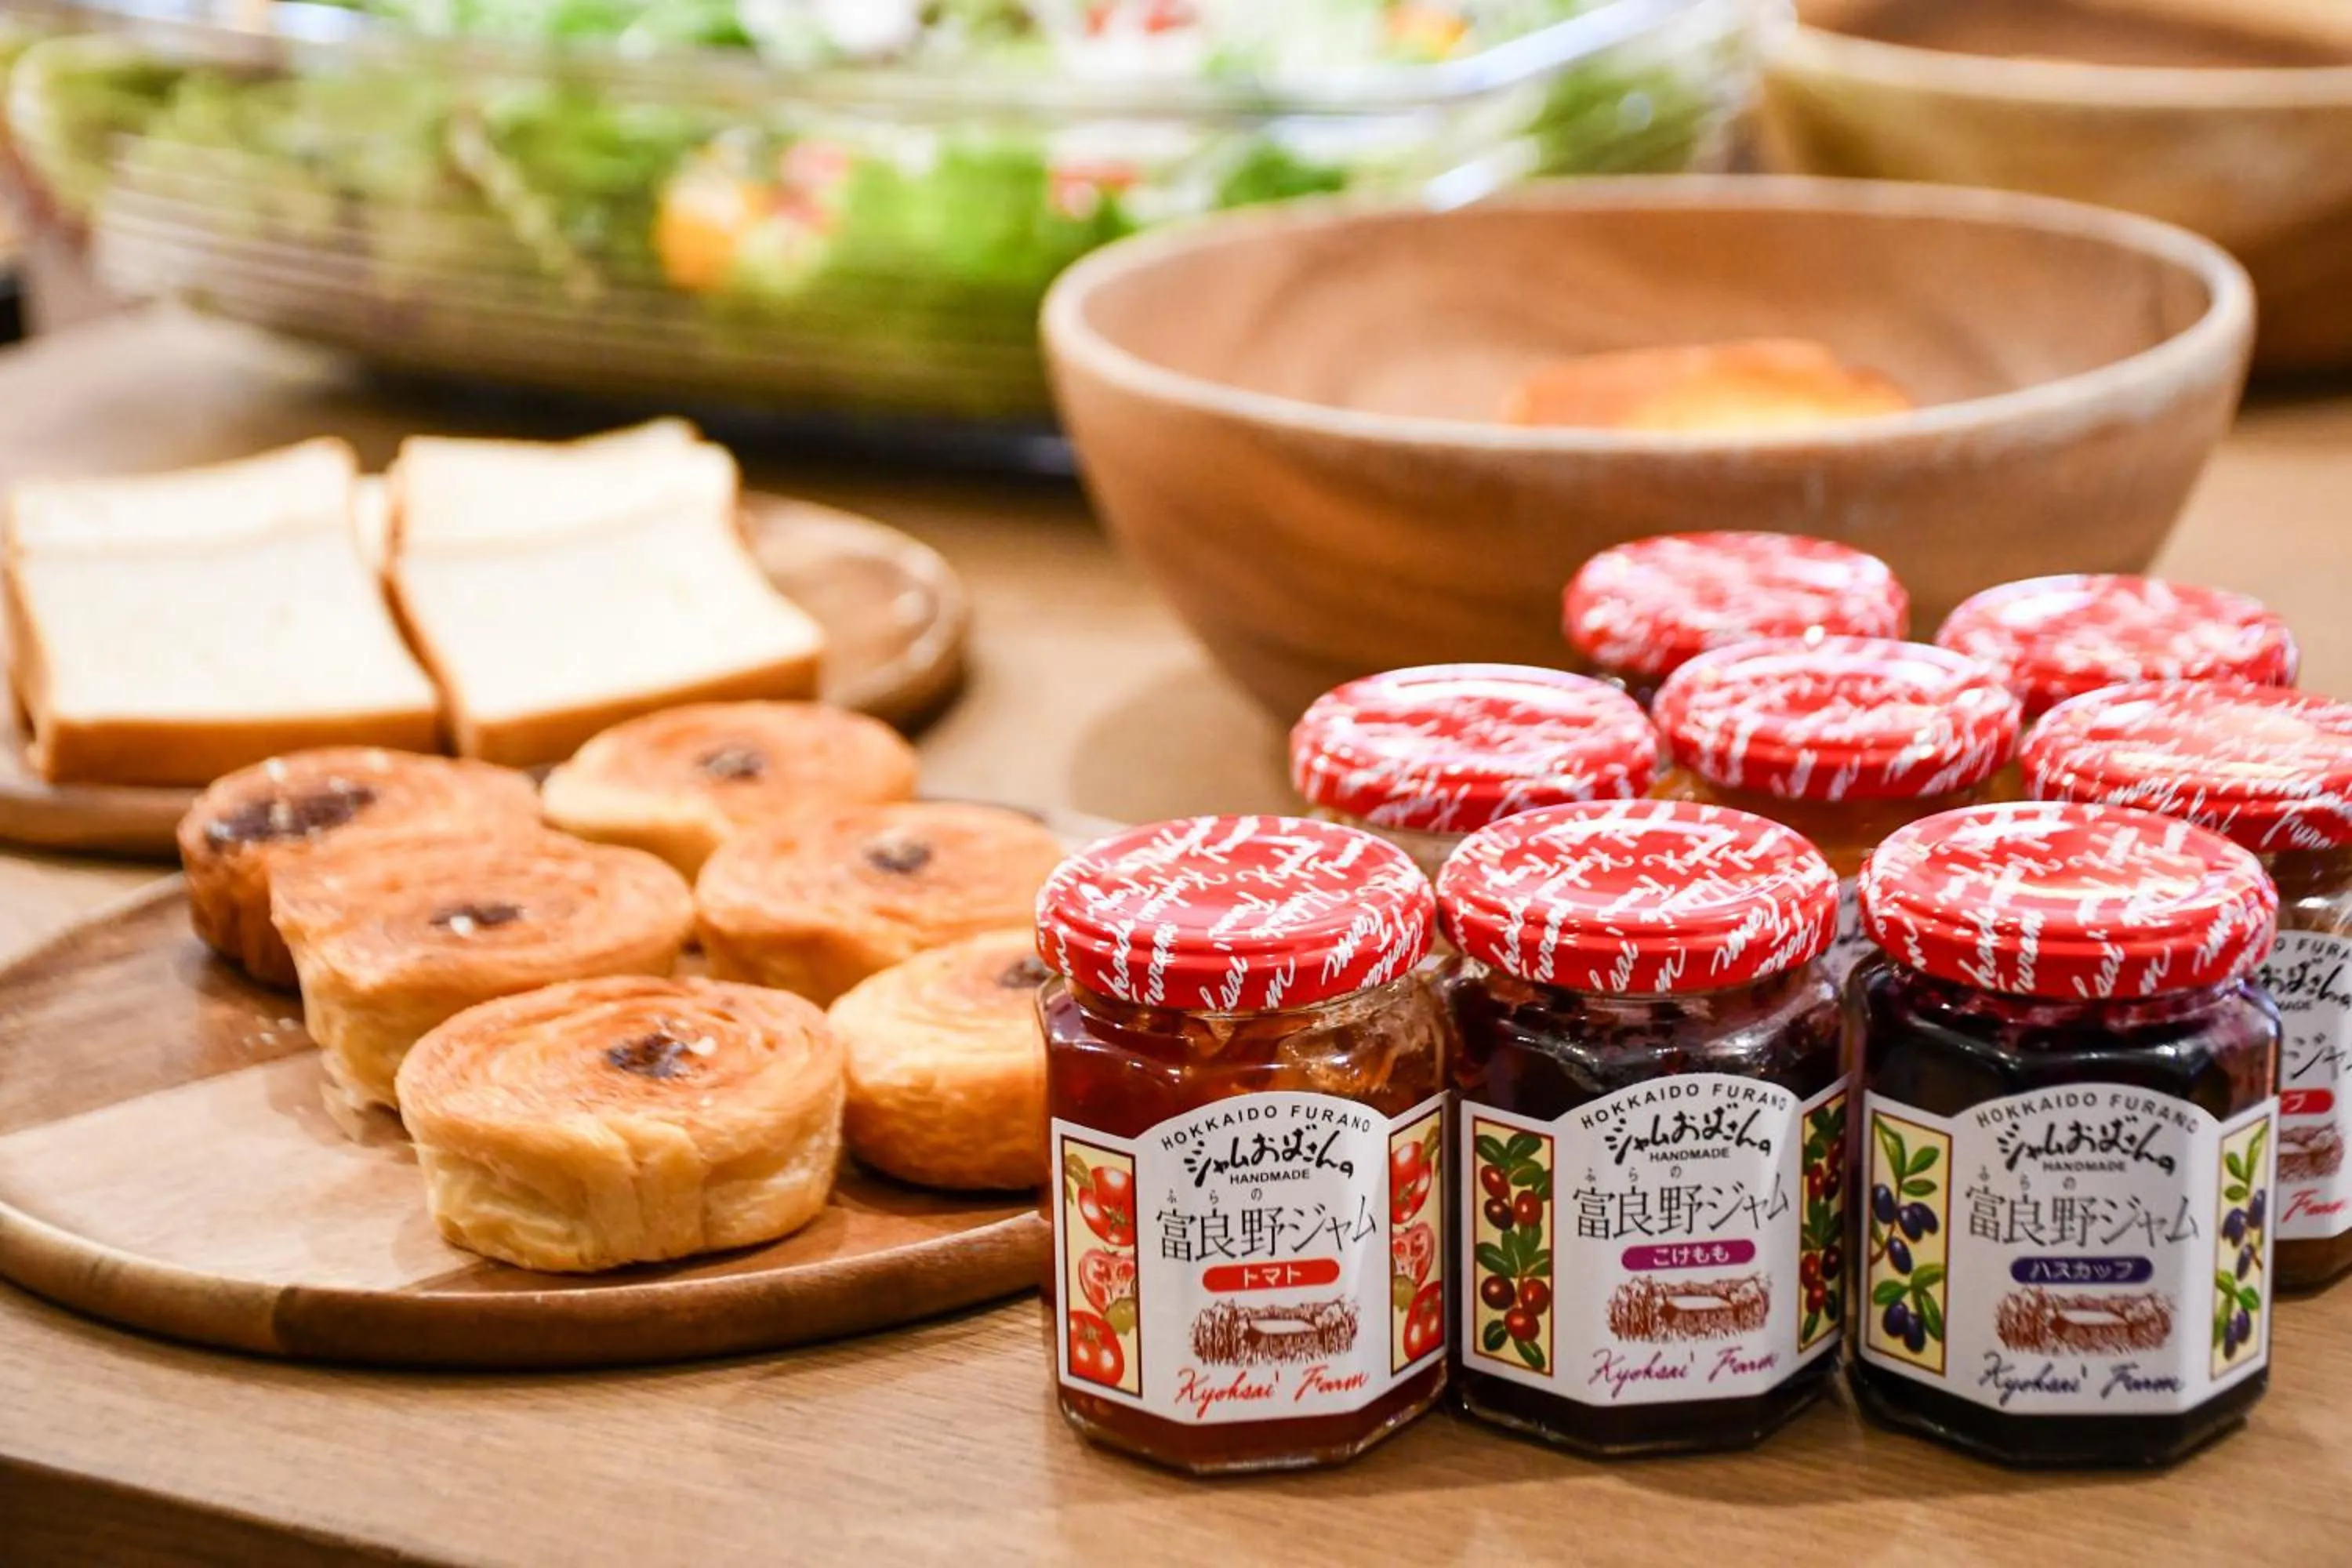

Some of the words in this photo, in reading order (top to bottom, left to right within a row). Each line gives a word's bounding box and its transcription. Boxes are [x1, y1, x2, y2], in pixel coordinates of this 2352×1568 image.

[1581, 1083, 1700, 1129] HOKKAIDO
[1712, 1083, 1788, 1112] FURANO
[1976, 1092, 2098, 1129] HOKKAIDO
[2109, 1094, 2200, 1134] FURANO
[1160, 1105, 1278, 1151] HOKKAIDO
[1290, 1105, 1372, 1134] FURANO
[1649, 1146, 1731, 1163] HANDMADE
[2042, 1159, 2127, 1174] HANDMADE
[1229, 1168, 1311, 1186] HANDMADE
[1572, 1172, 1791, 1241] 富良野ジャム
[1964, 1185, 2201, 1249] 富良野ジャム
[1156, 1195, 1377, 1264] 富良野ジャム
[1653, 1245, 1730, 1267] こけもも
[2029, 1260, 2134, 1279] ハスカップ
[1241, 1265, 1303, 1287] トマト
[1708, 1346, 1780, 1383] Farm
[1294, 1365, 1370, 1403] Farm
